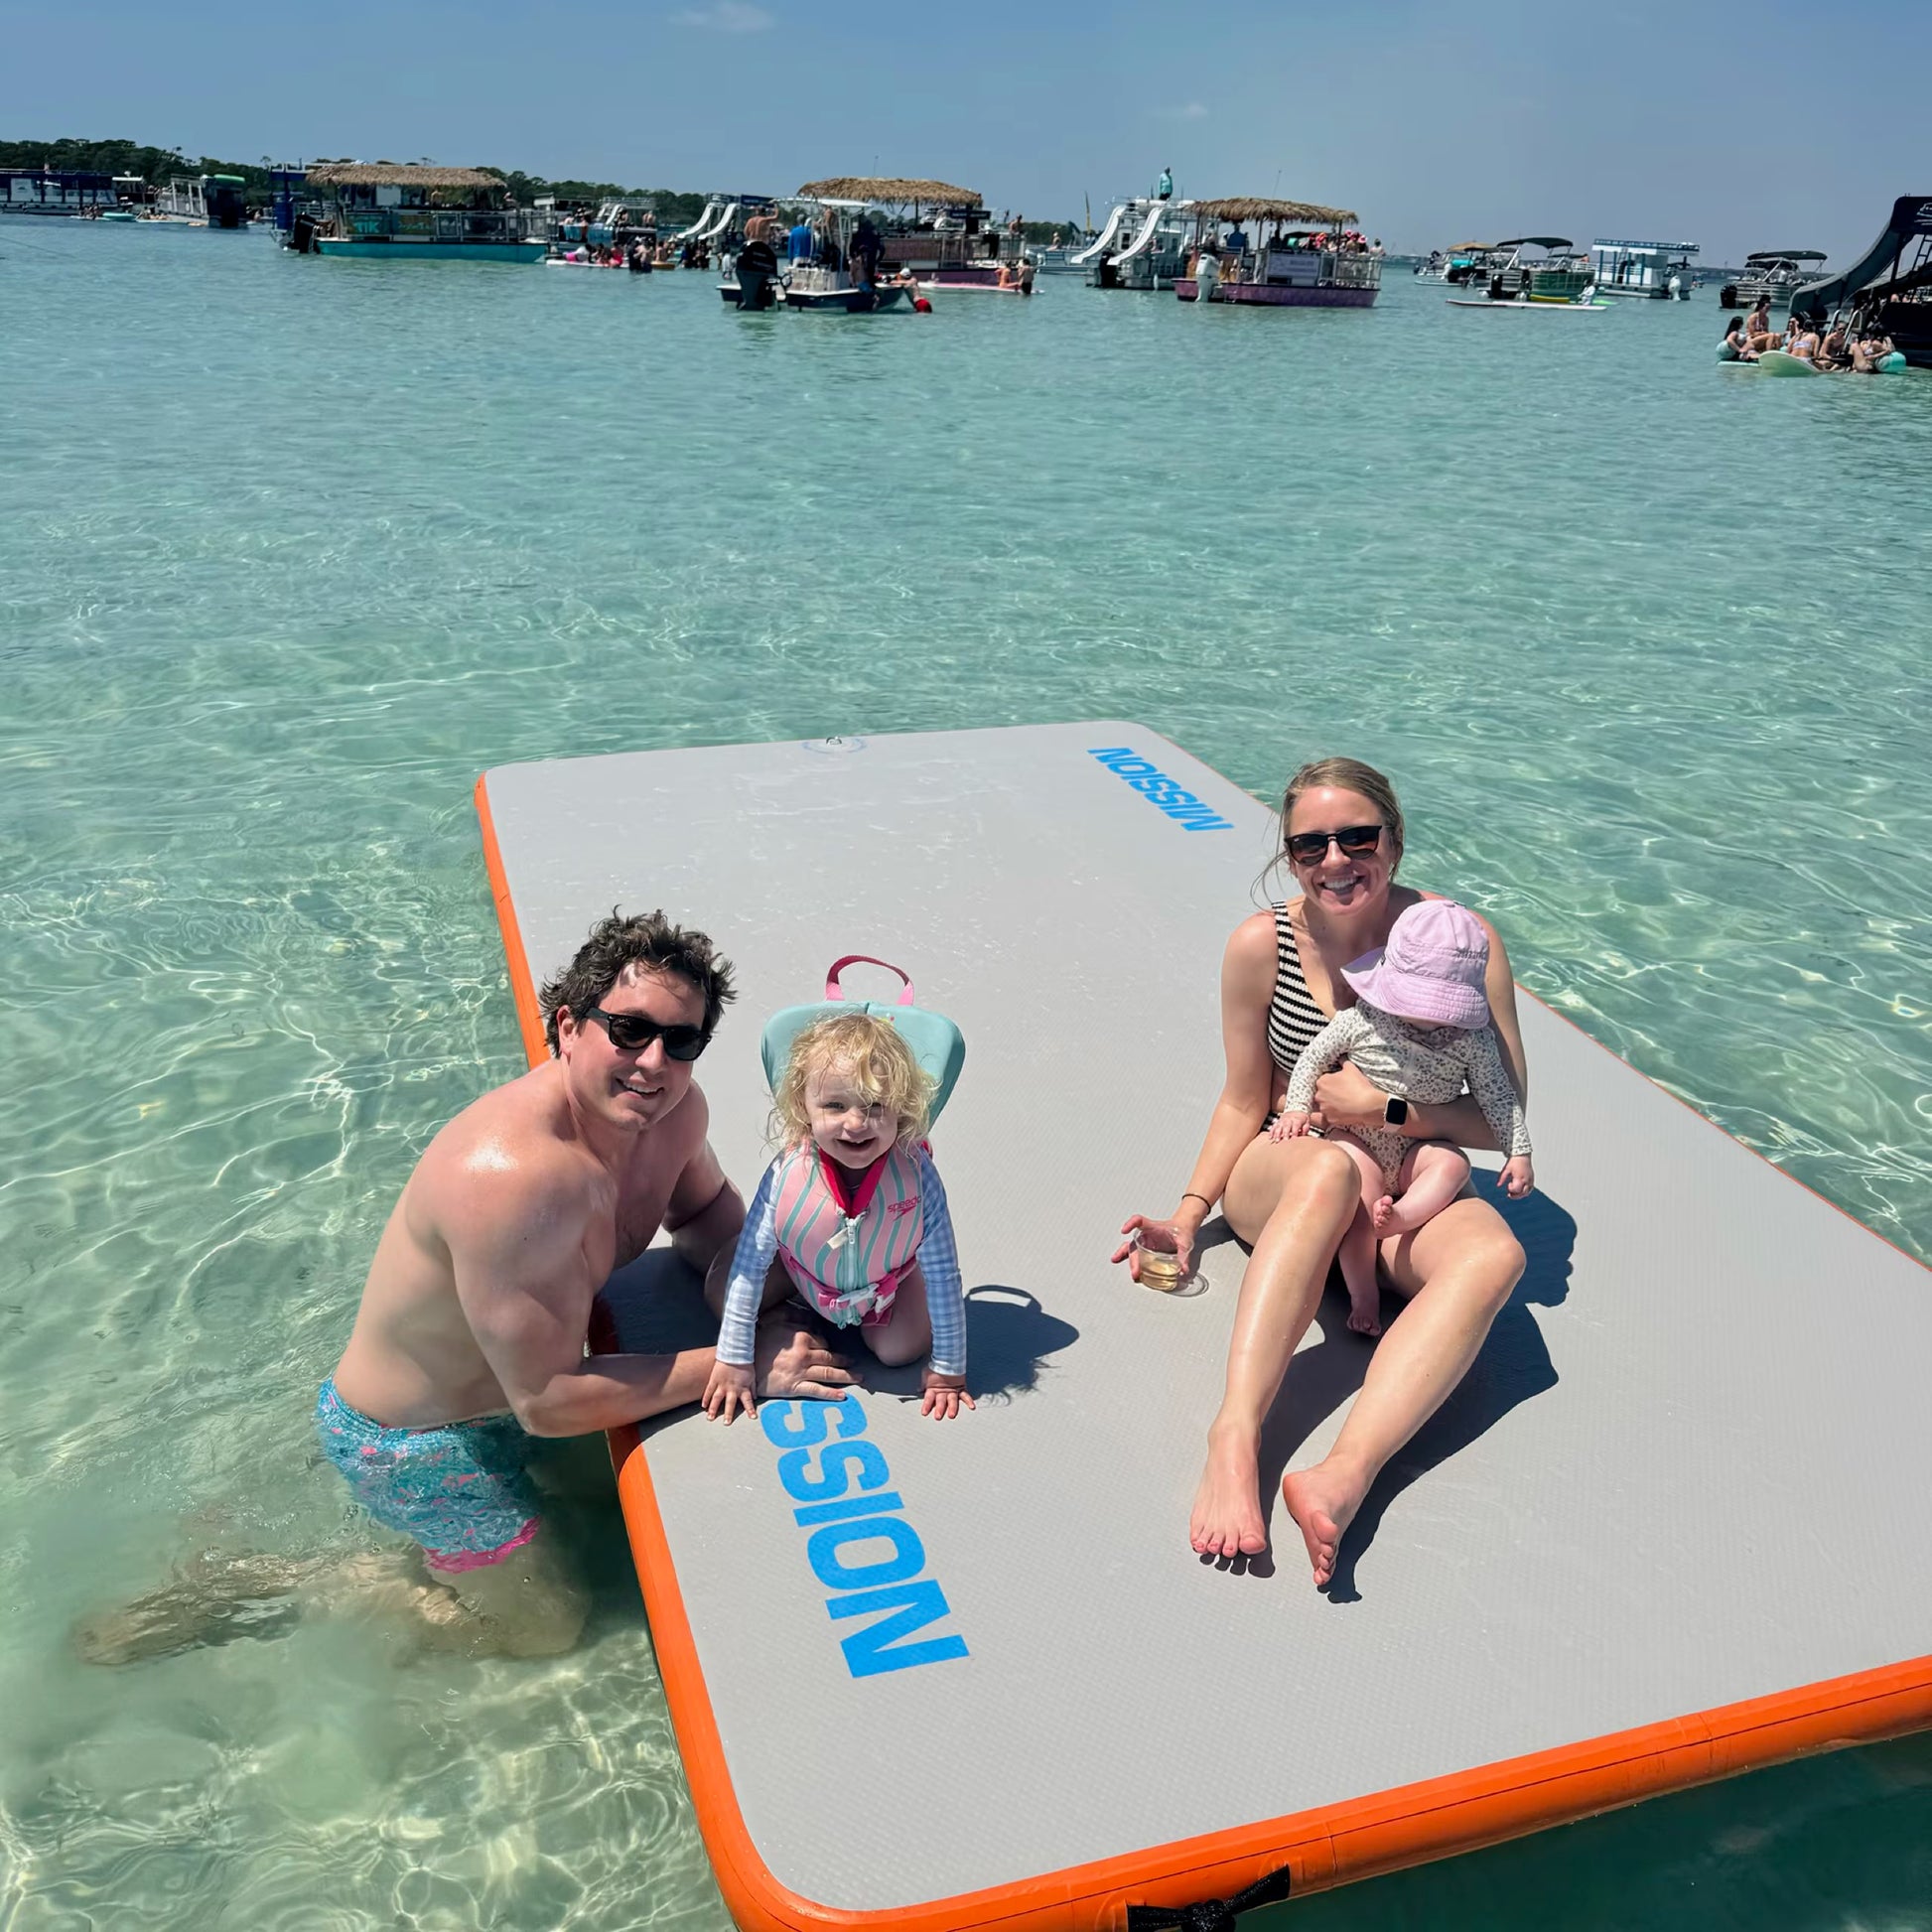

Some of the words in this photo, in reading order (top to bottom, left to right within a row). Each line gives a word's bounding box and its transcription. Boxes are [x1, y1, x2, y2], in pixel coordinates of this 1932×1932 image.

[1087, 748, 1235, 831] MISSION
[888, 1195, 922, 1213] speedo
[759, 1393, 969, 1678] SSION
